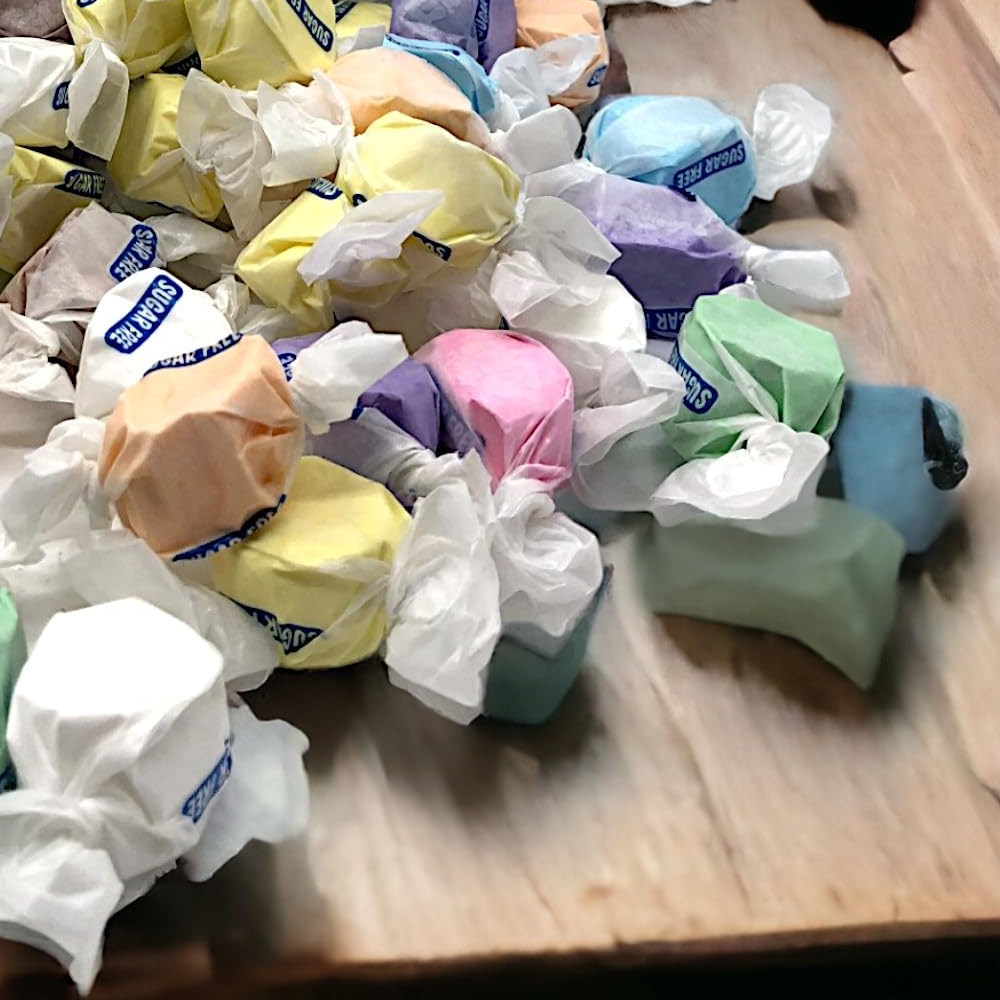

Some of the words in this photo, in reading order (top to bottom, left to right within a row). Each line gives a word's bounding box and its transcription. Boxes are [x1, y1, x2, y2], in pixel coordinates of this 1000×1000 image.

[302, 3, 333, 47] SUGAR
[704, 143, 745, 174] SUGAR
[677, 161, 703, 189] FREE
[130, 279, 178, 330] SUGAR
[108, 321, 144, 350] FREE
